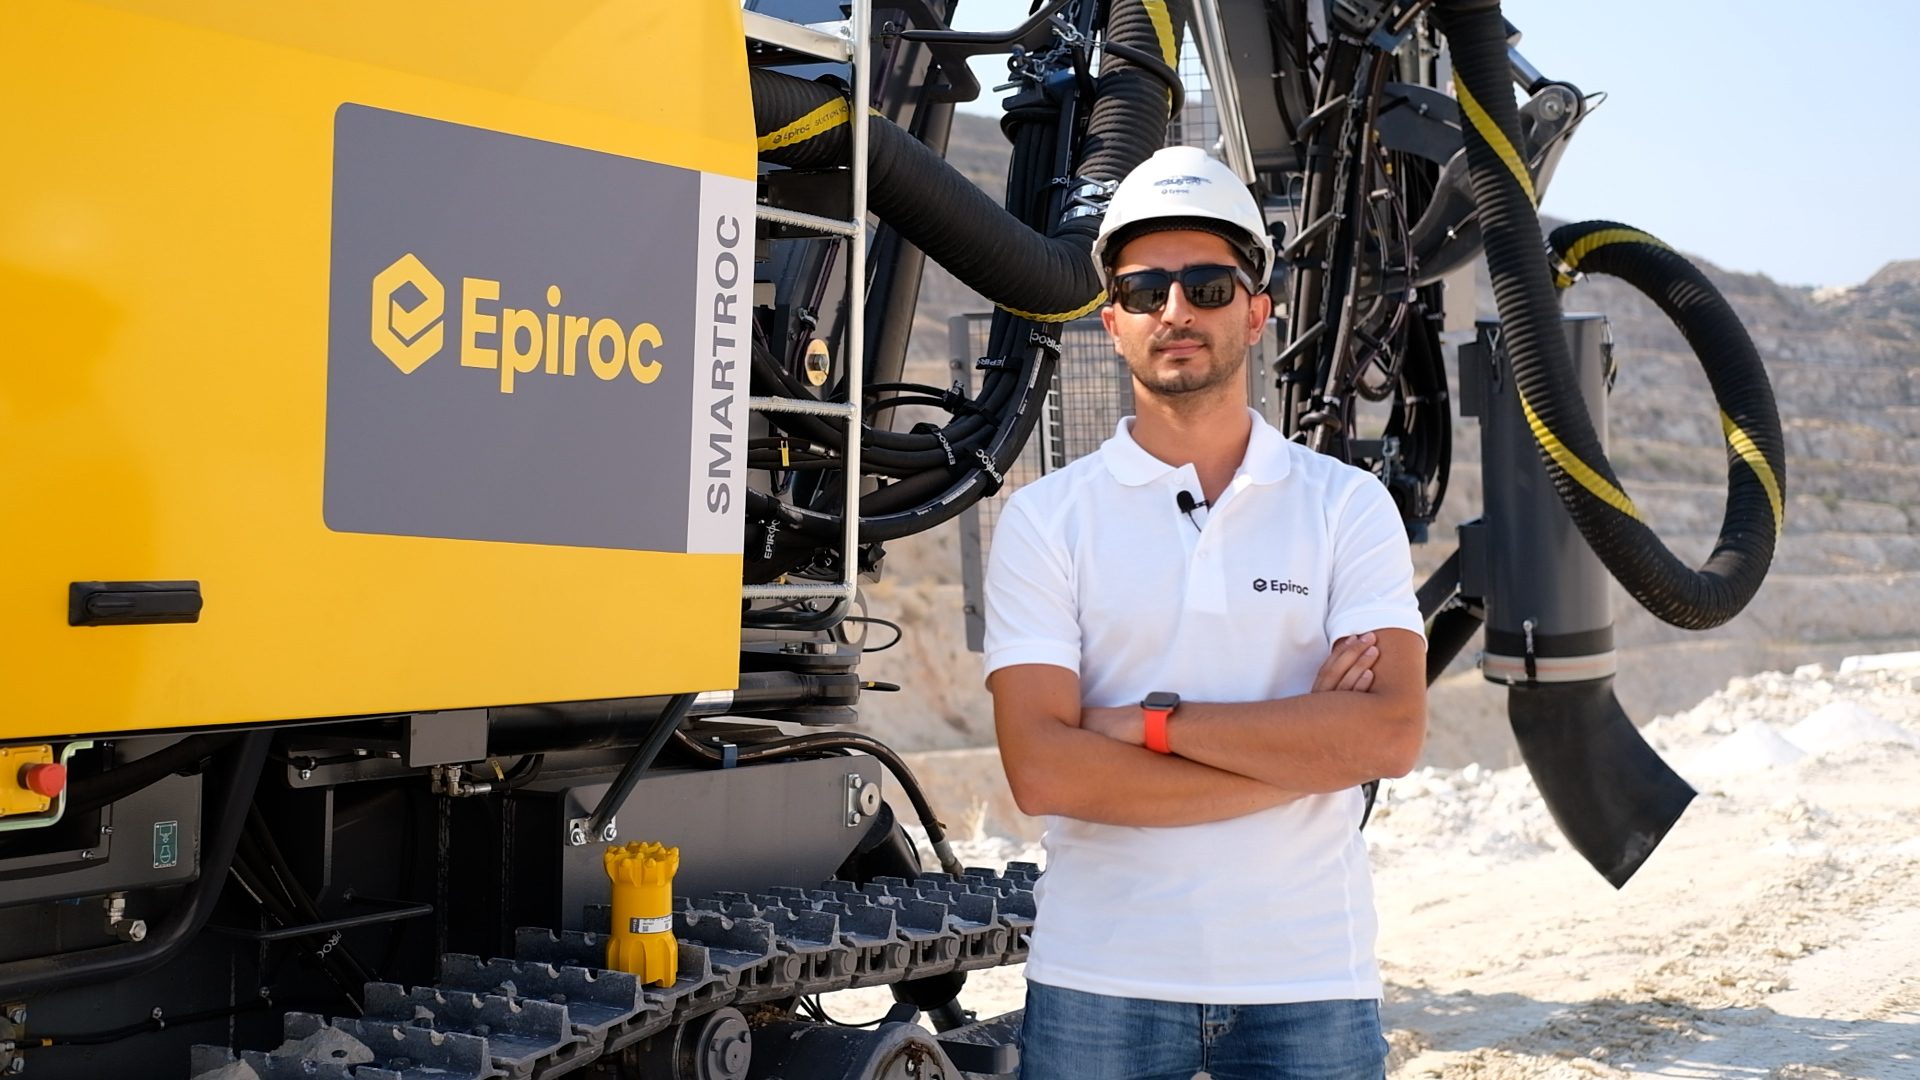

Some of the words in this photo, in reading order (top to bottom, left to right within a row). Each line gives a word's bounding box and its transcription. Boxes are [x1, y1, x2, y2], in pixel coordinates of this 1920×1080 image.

[460, 276, 664, 394] Epiroc
[706, 214, 741, 515] SMARTROC
[976, 449, 1003, 483] EPIROC
[764, 519, 781, 560] EPIROC
[1270, 579, 1309, 596] Epiroc
[316, 929, 342, 959] PIROC
